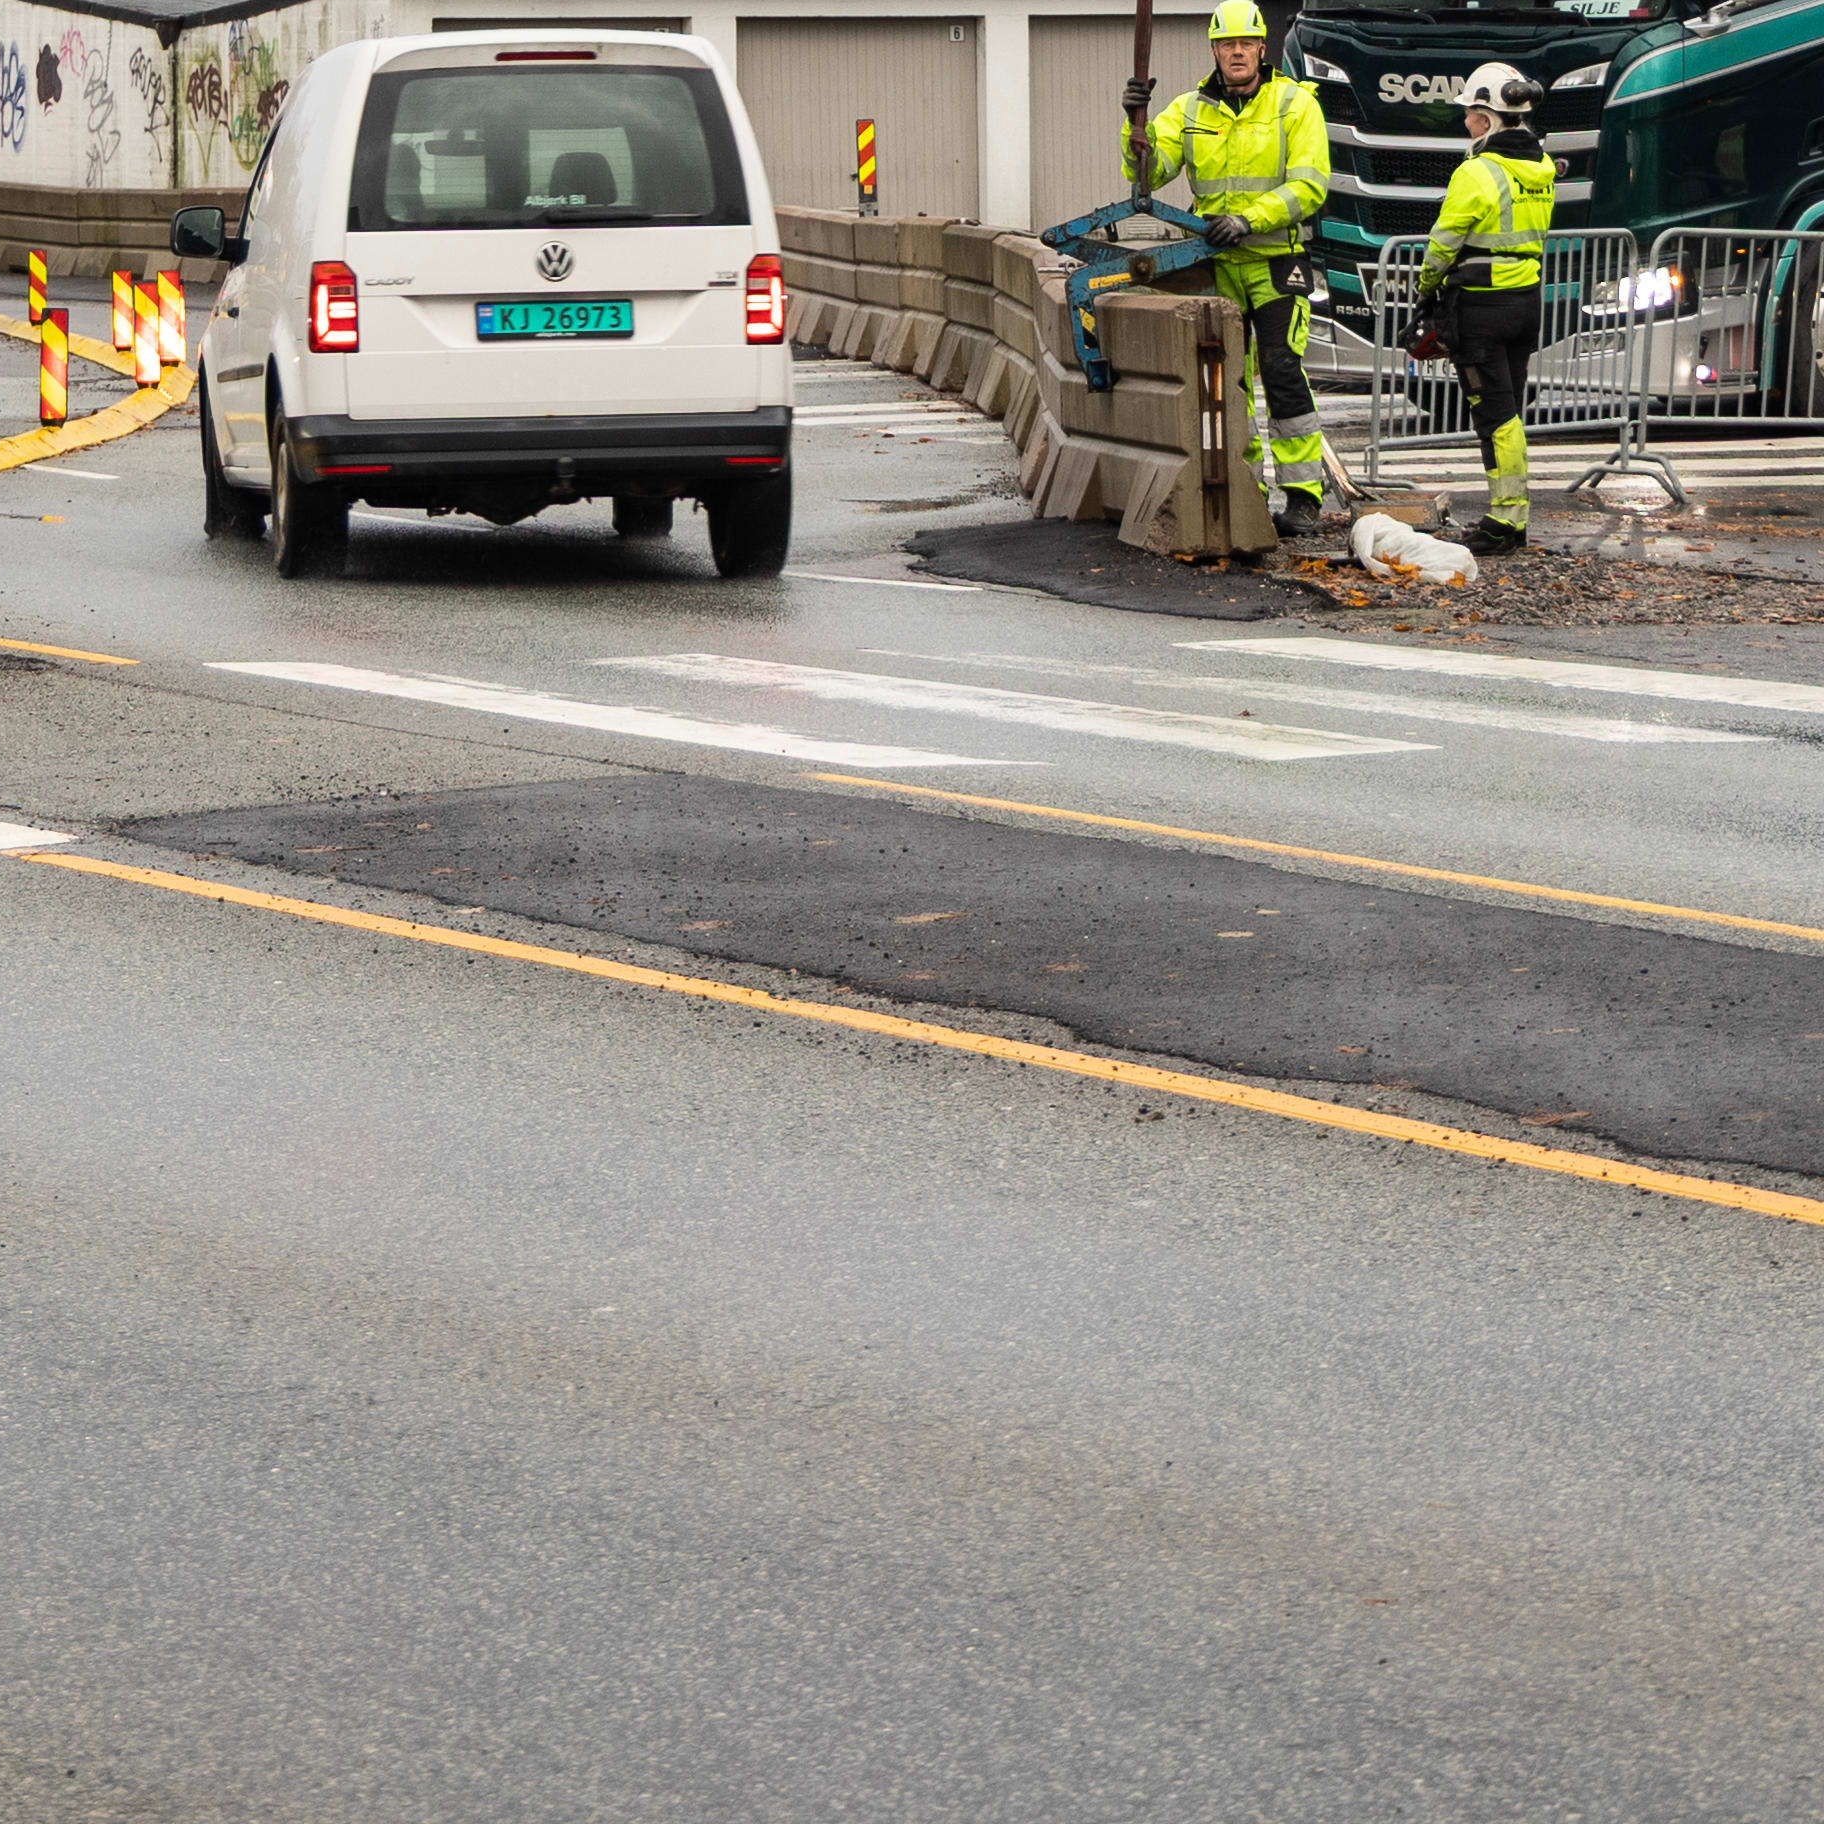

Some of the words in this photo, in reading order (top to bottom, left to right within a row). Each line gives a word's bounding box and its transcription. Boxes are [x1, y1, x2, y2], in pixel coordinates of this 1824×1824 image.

[1570, 1, 1621, 16] SILJE
[953, 26, 961, 39] 6
[364, 276, 415, 287] CADDY
[499, 308, 531, 330] KJ
[544, 306, 622, 330] 26973
